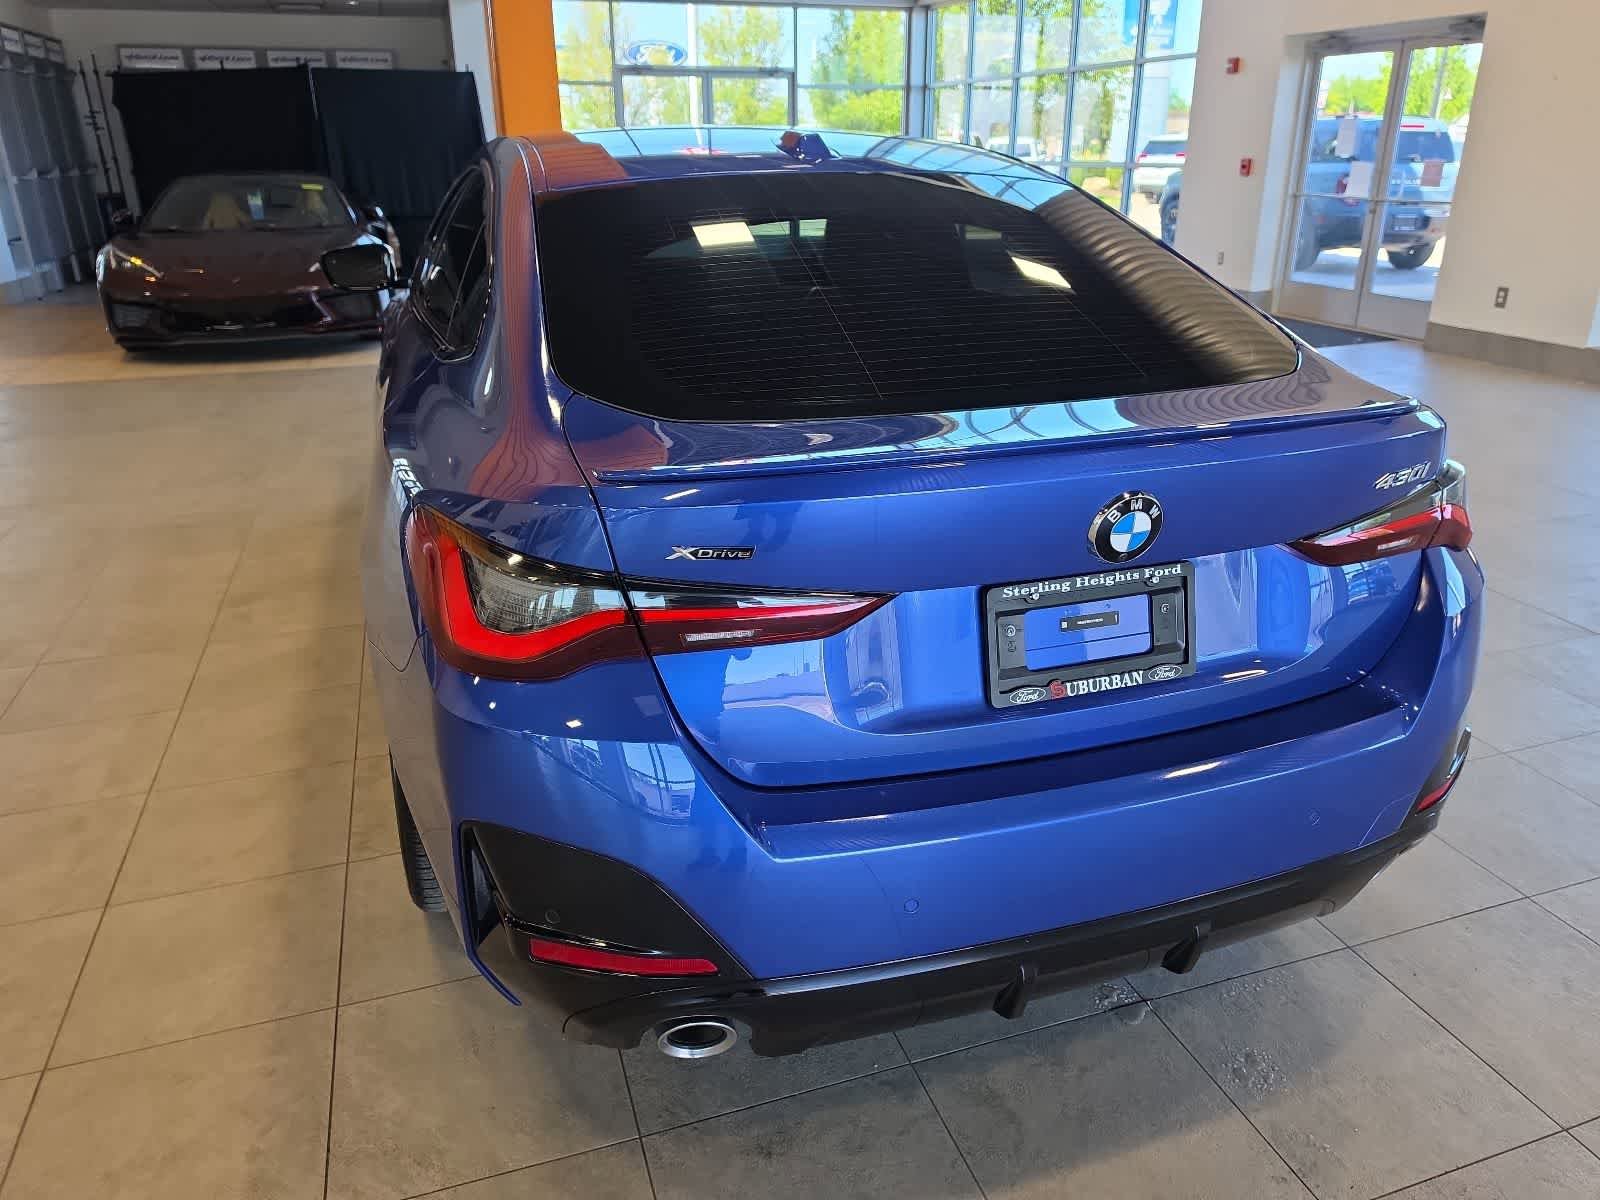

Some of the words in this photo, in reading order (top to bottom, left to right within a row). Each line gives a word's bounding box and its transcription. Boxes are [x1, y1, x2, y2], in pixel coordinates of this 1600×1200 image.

[1107, 498, 1161, 524] BMW
[1002, 580, 1071, 599] Sterling
[1076, 570, 1140, 588] Heights
[1143, 564, 1182, 578] Ford
[1015, 689, 1040, 703] Ford
[1049, 670, 1144, 699] SUBURBAN
[1154, 666, 1177, 680] Ford
